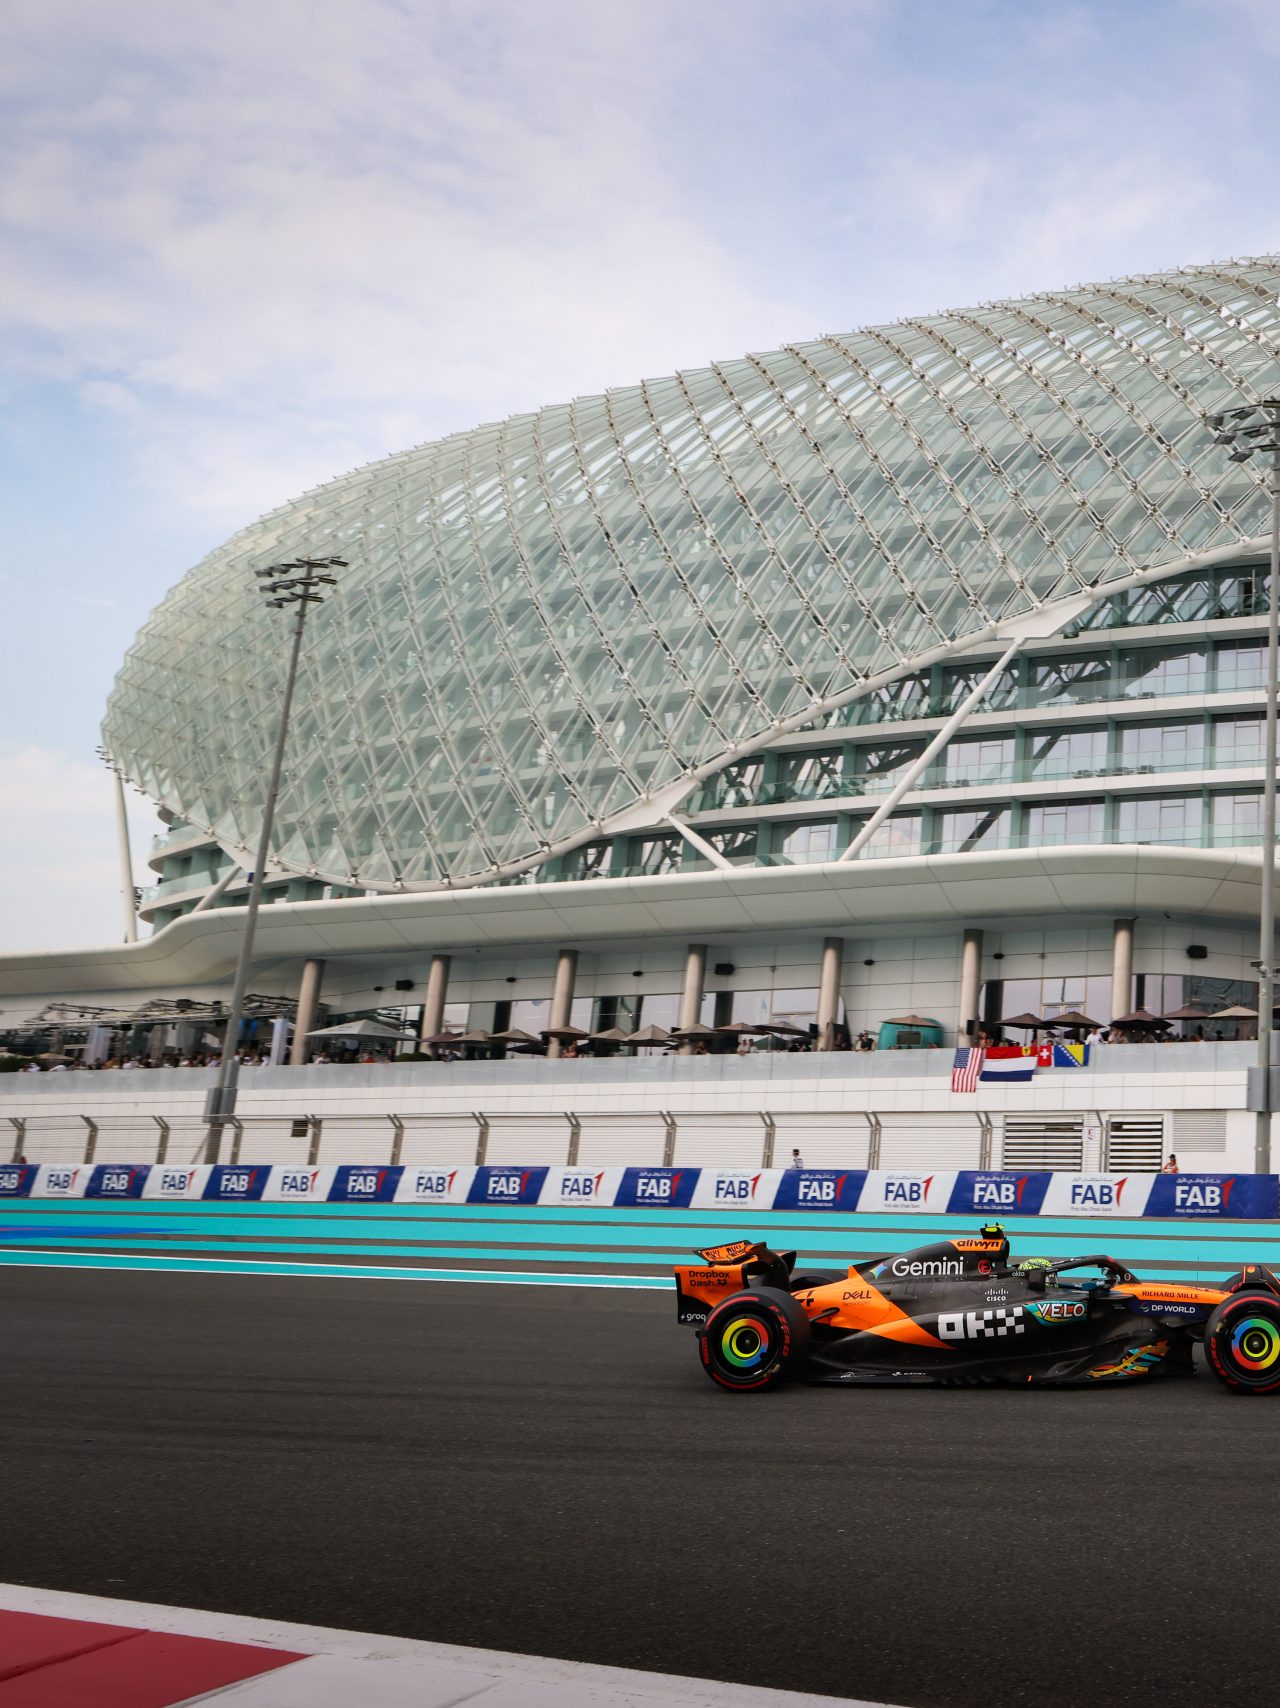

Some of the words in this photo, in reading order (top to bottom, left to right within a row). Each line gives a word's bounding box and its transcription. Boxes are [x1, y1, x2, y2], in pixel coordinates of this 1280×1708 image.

[956, 1239, 999, 1250] allwyn
[891, 1256, 964, 1277] Gemini
[688, 1270, 730, 1279] Dropbox
[690, 1279, 714, 1287] Dash
[842, 1290, 872, 1300] DELL
[1142, 1290, 1175, 1298] RICHARD
[1176, 1292, 1200, 1300] MILLE
[1037, 1303, 1085, 1318] VELO
[1151, 1304, 1163, 1312] DP
[1164, 1305, 1196, 1314] WORLD
[686, 1313, 706, 1322] groq
